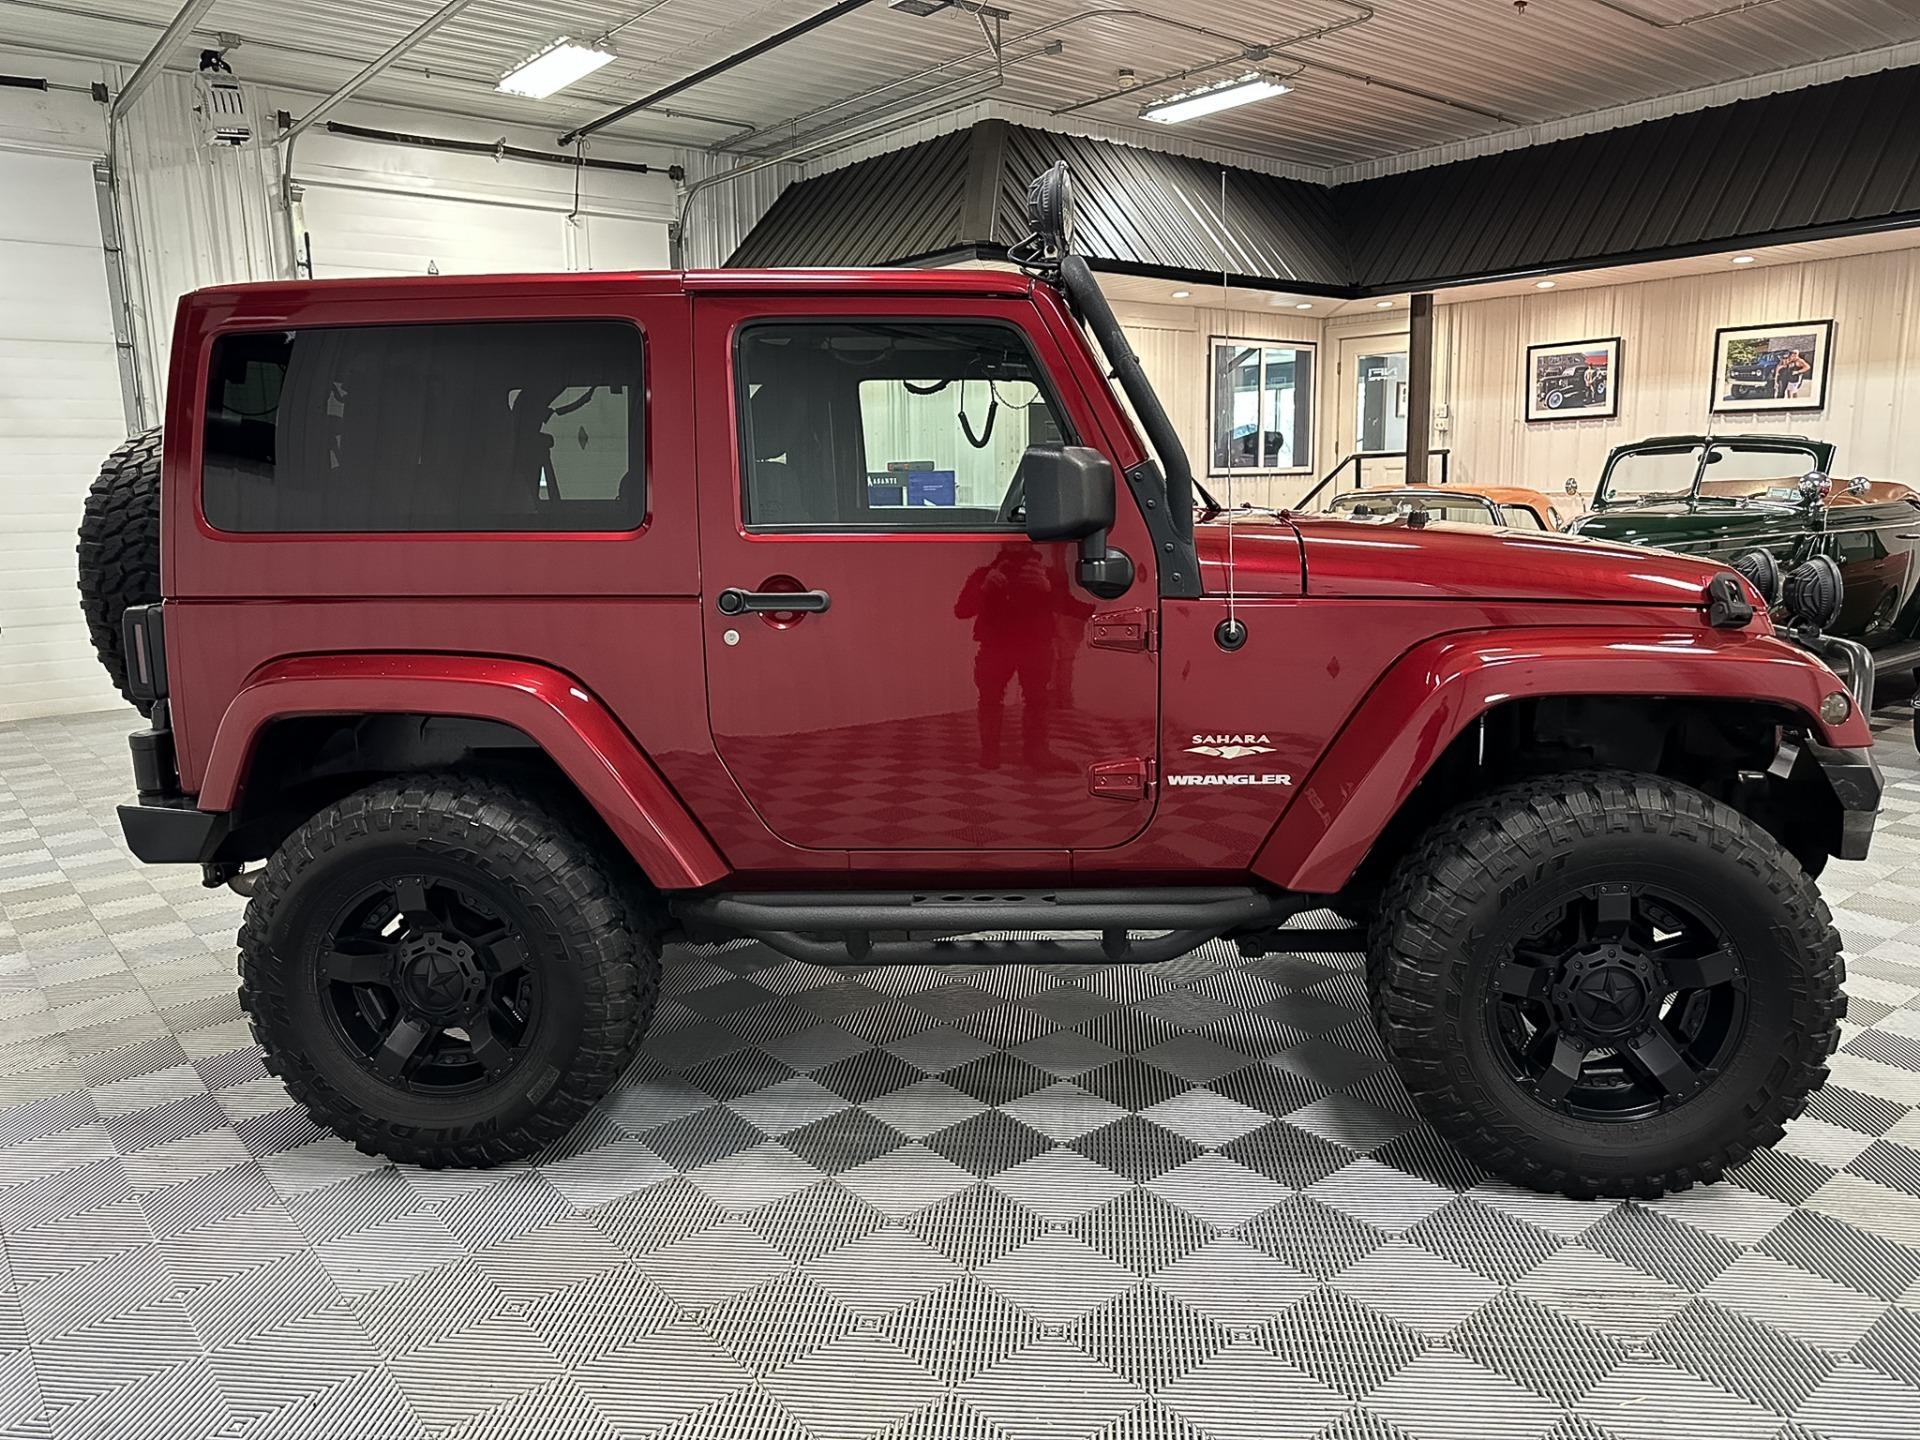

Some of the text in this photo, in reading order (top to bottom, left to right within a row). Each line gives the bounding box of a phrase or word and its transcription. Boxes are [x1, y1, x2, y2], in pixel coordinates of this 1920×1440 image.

[1191, 734, 1271, 744] SAHARA
[1166, 774, 1293, 786] WRANGLER
[1443, 848, 1577, 1150] WILDPEAK M/T
[281, 1046, 502, 1141] WILDPEAK
